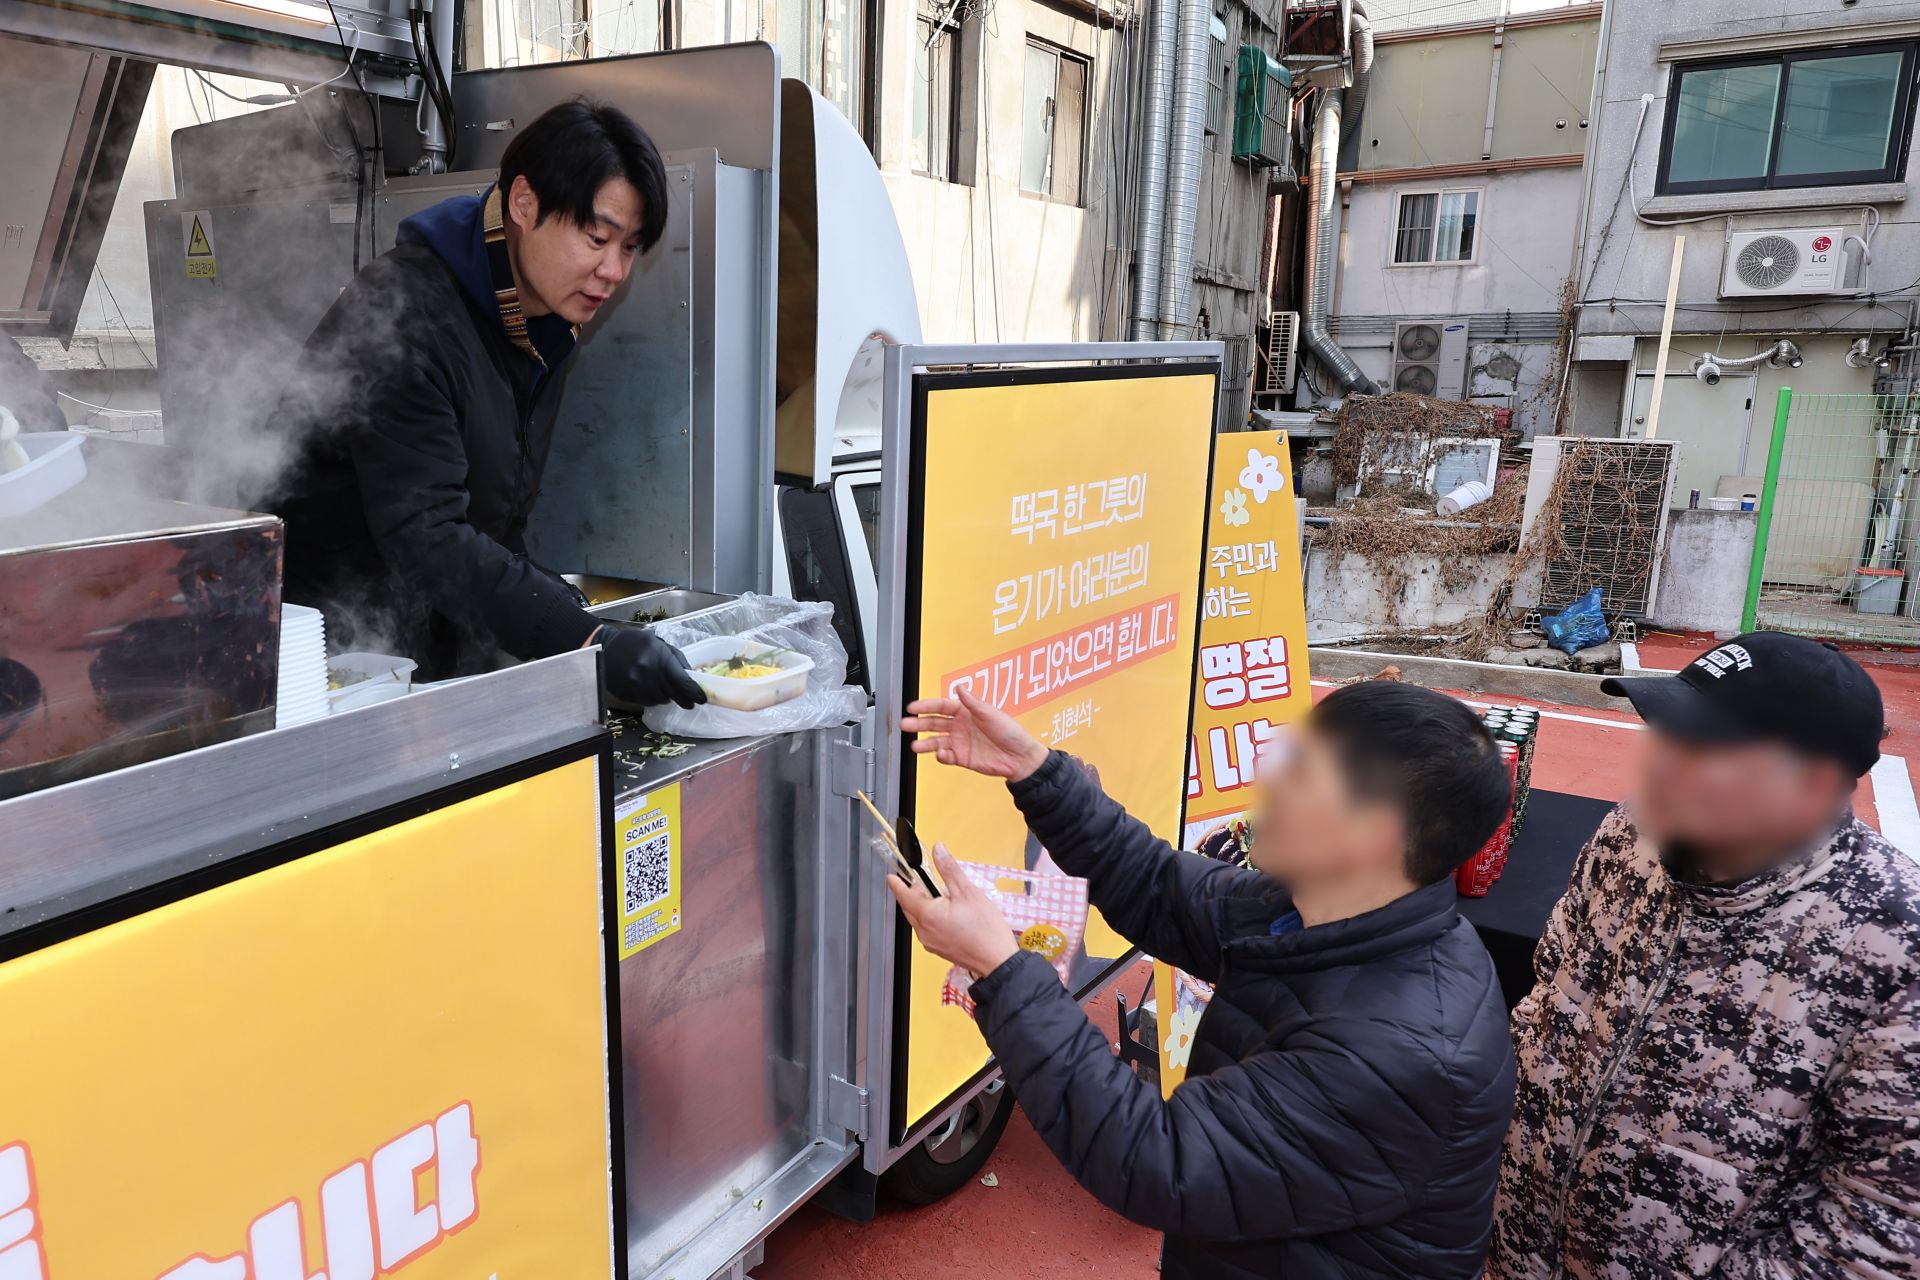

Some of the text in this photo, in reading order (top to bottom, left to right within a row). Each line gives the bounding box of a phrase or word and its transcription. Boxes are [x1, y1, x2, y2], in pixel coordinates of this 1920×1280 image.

[189, 262, 215, 275] 고압전기
[1811, 255, 1827, 263] LG
[1011, 489, 1058, 544] 떡국
[1211, 541, 1279, 578] 주민과
[992, 541, 1150, 636] 온기가 여러분의
[1202, 586, 1252, 621] 하는
[1027, 622, 1115, 699] 되었으면
[1117, 601, 1176, 662] 합니다.
[1201, 635, 1291, 710] 명절
[1051, 698, 1093, 745] 최현석
[626, 823, 651, 842] SCAN
[651, 816, 667, 832] ME!
[153, 1098, 482, 1280] 니다
